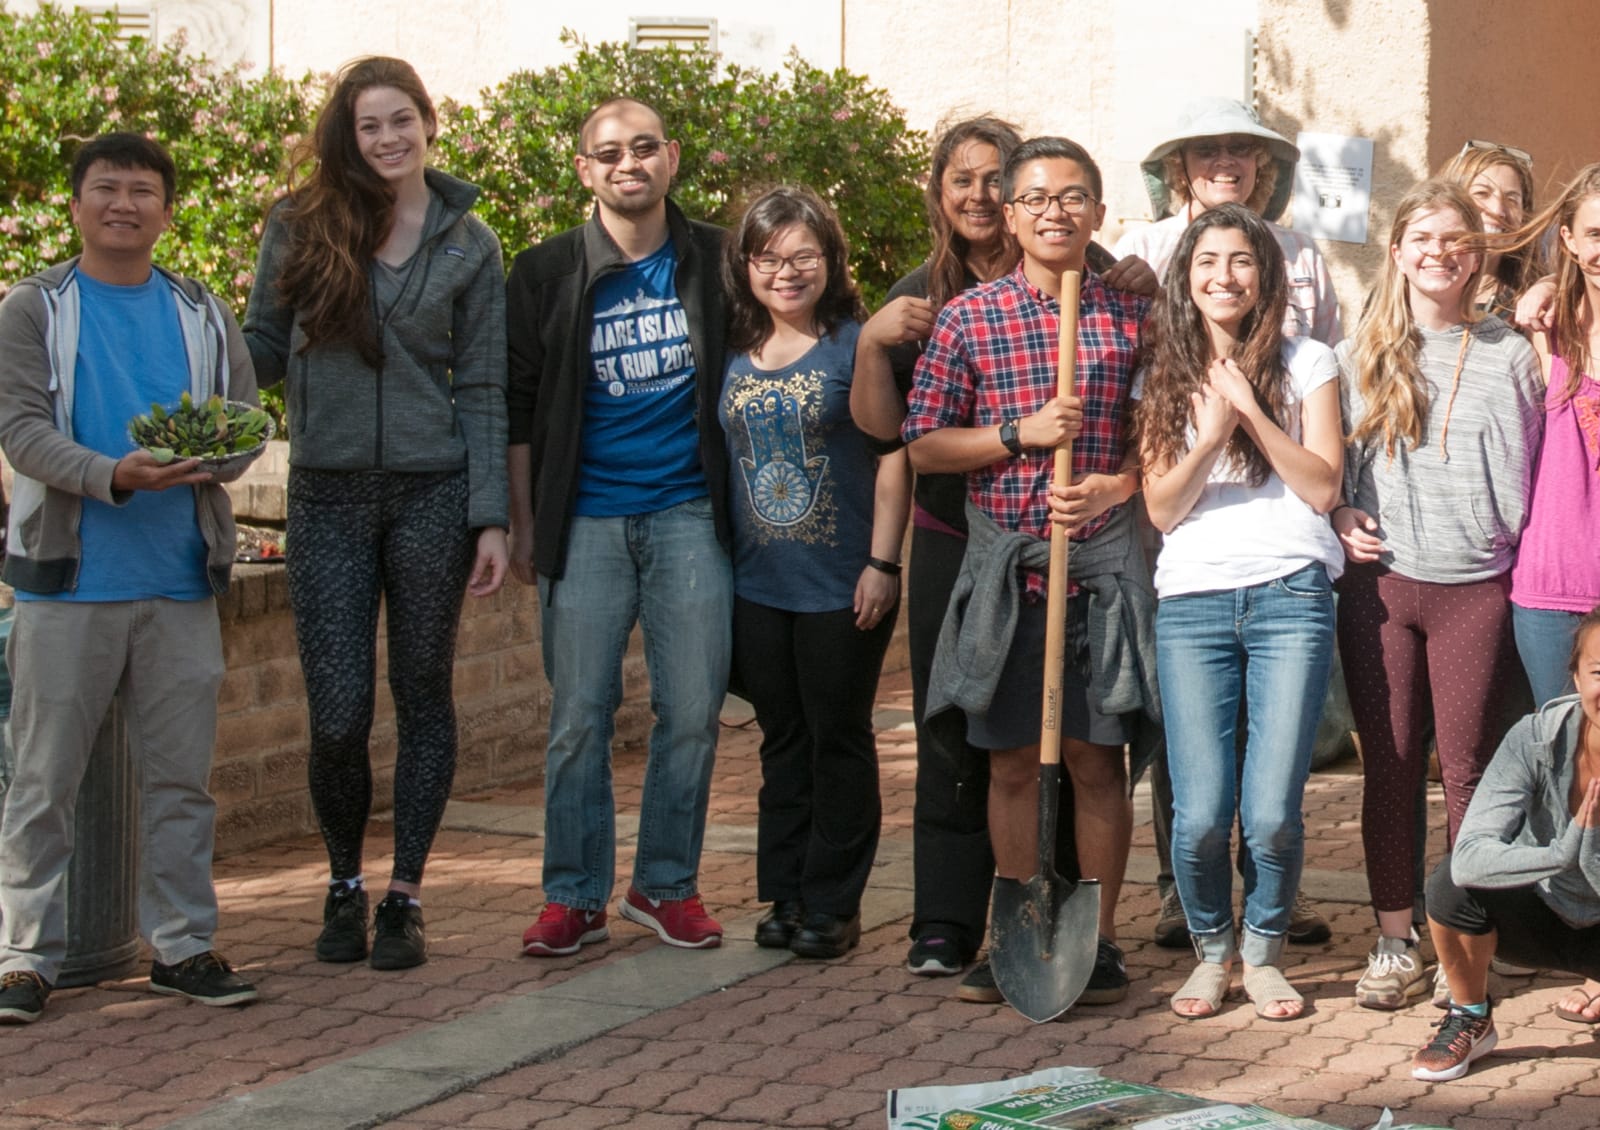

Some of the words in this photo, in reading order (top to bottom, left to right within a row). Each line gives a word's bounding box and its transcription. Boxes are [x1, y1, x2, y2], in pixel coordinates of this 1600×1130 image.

[591, 319, 638, 353] MARE
[637, 308, 689, 343] ISLAN
[595, 356, 620, 382] 5K
[620, 349, 659, 380] RUN
